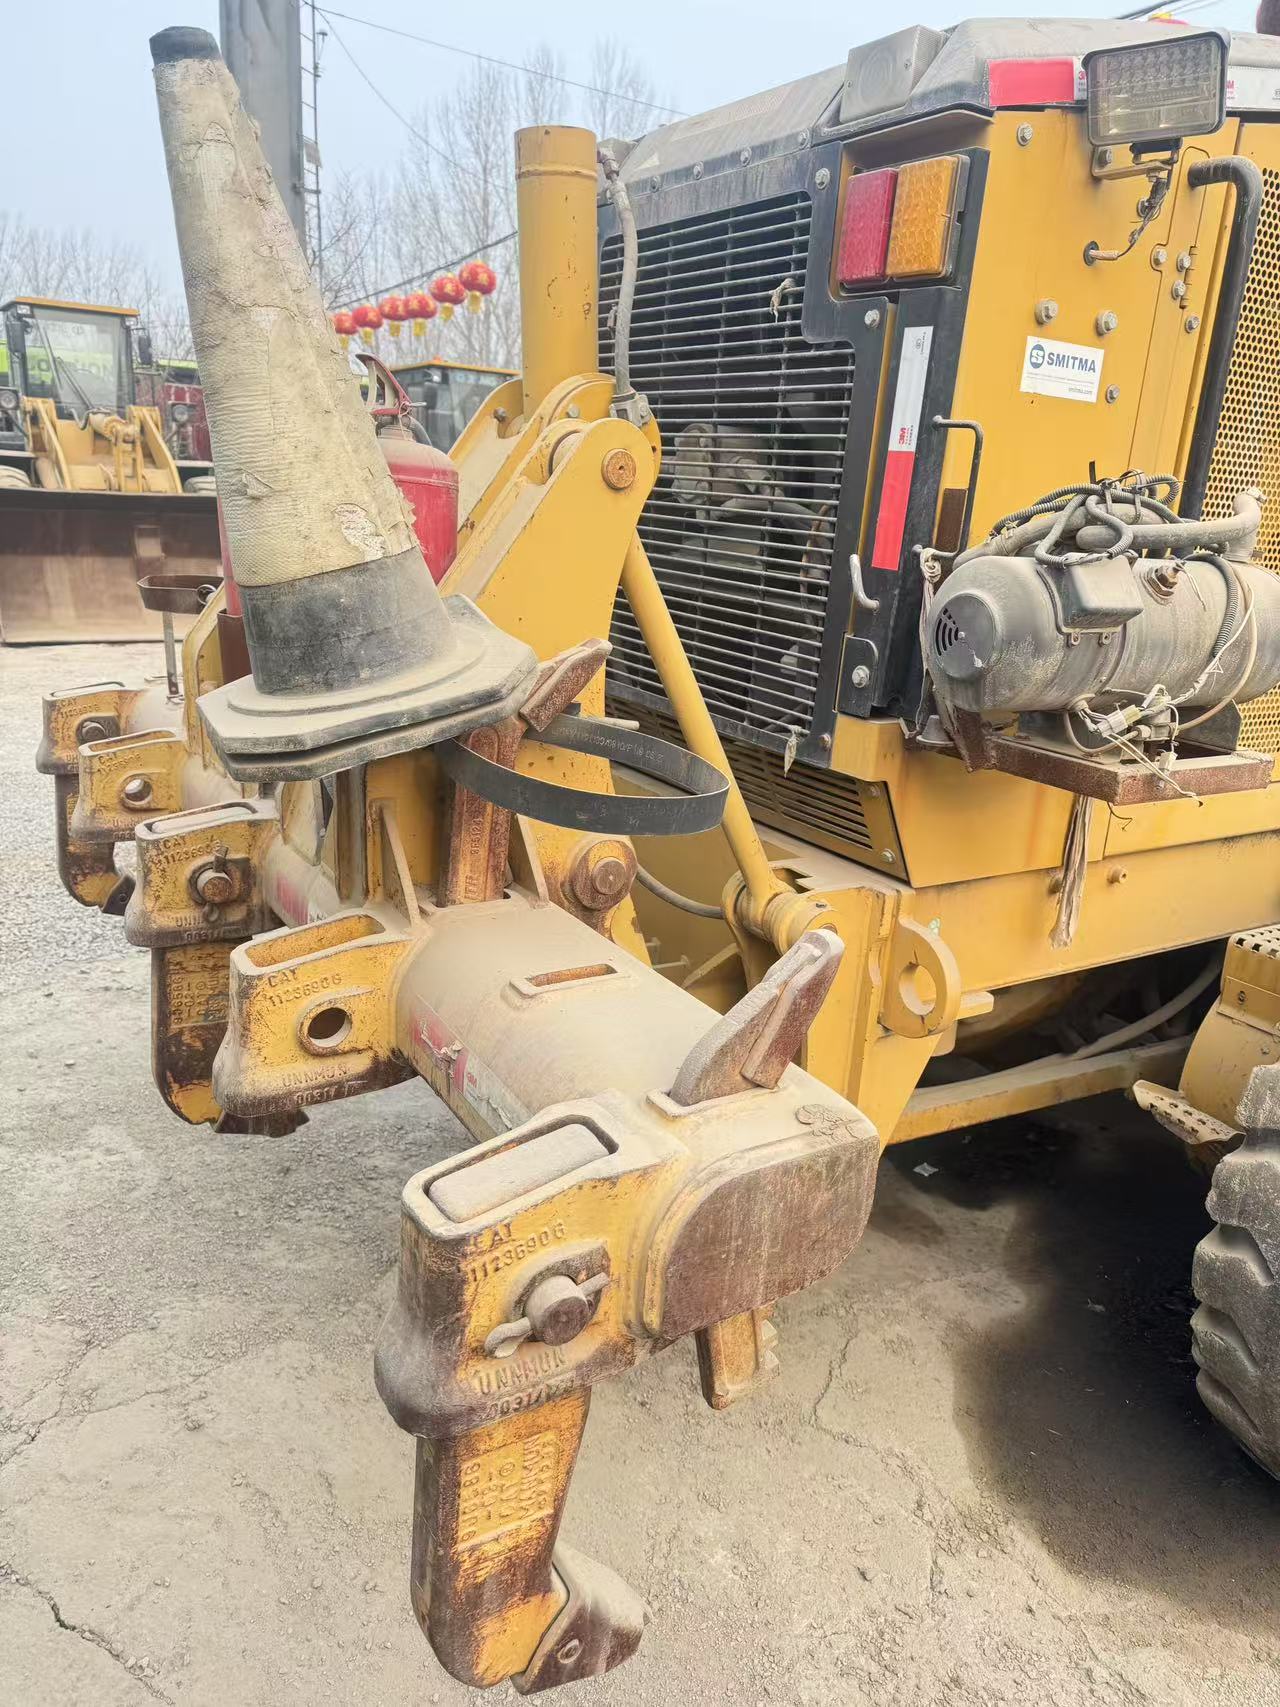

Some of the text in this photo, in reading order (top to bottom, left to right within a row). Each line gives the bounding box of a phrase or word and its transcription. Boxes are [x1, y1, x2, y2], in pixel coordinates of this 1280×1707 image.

[1047, 352, 1096, 373] SMITMA
[898, 426, 907, 446] 3M
[163, 836, 186, 850] CAT
[267, 968, 299, 988] CAT
[472, 1223, 514, 1249] CAT
